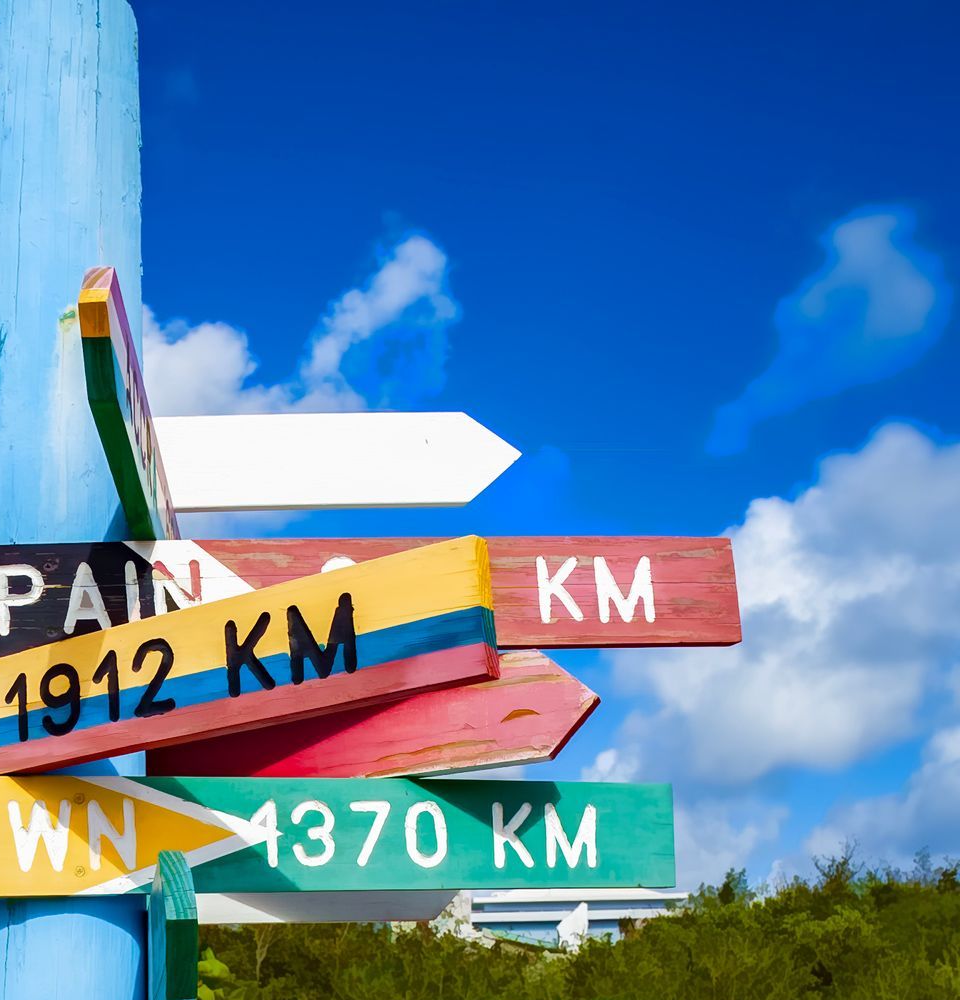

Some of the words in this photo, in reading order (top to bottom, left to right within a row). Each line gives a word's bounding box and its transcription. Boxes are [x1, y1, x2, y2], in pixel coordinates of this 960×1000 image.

[535, 556, 656, 624] KM
[5, 637, 176, 742] 1912
[225, 592, 358, 698] KM
[247, 799, 448, 868] 1370
[492, 802, 597, 869] KM
